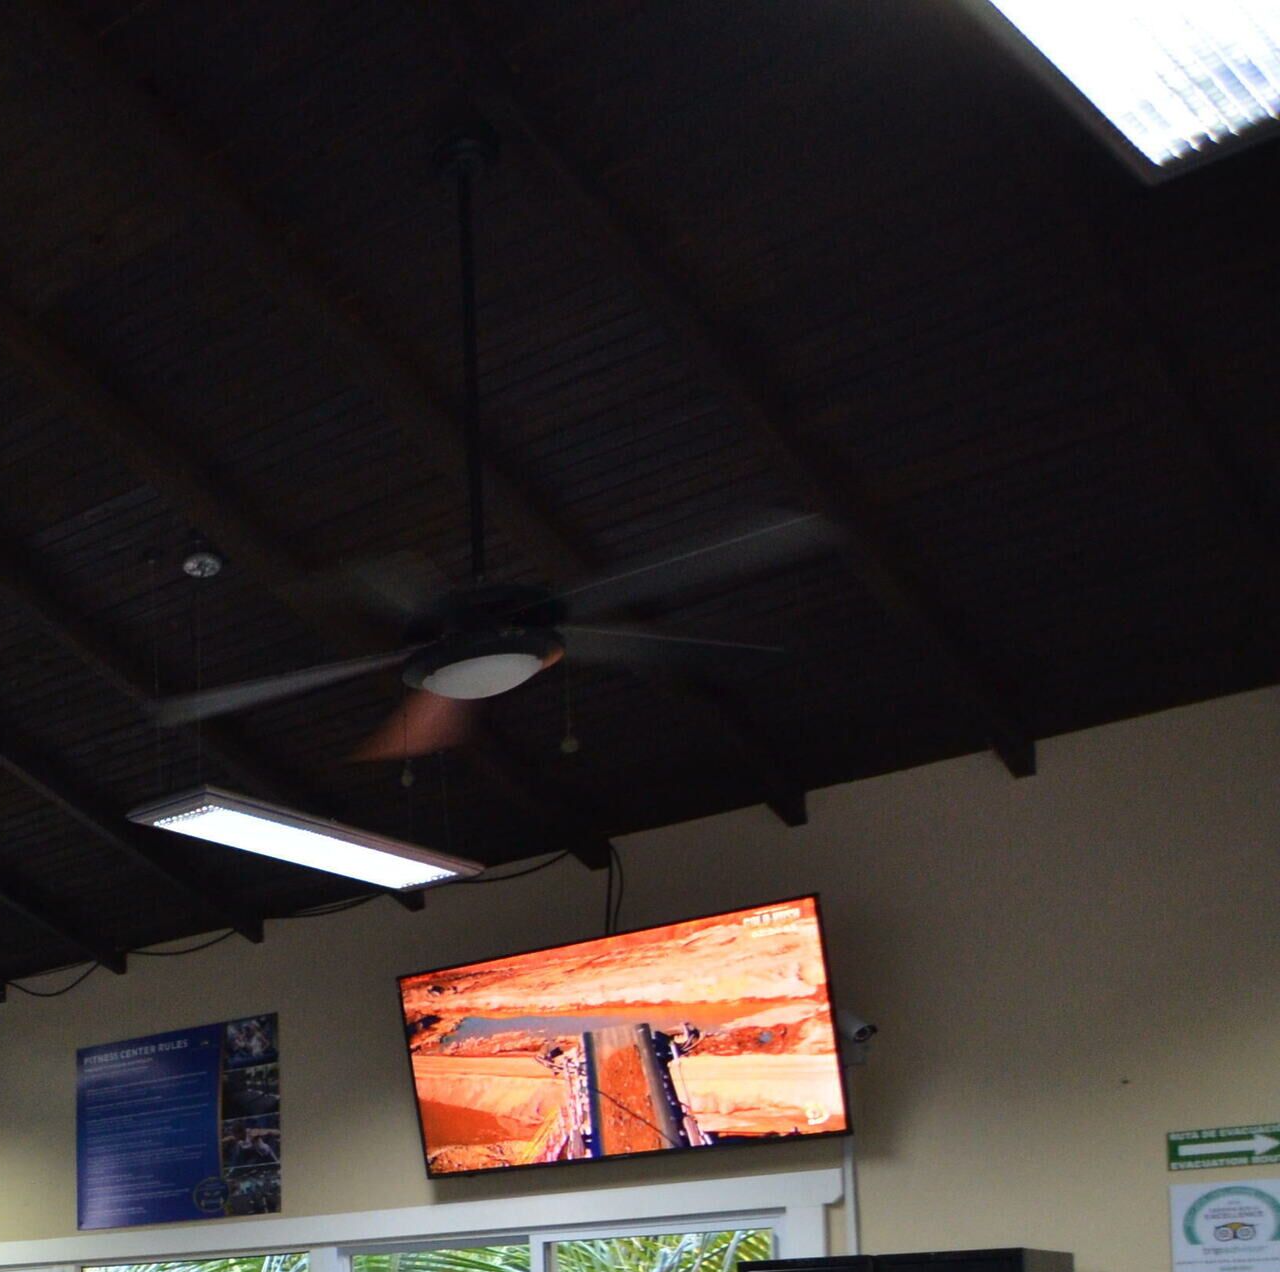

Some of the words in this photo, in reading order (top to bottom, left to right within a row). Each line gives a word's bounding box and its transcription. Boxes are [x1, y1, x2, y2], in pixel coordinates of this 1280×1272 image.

[83, 1051, 119, 1066] FITNESS
[120, 1045, 156, 1060] CENTER
[158, 1039, 189, 1053] RULES
